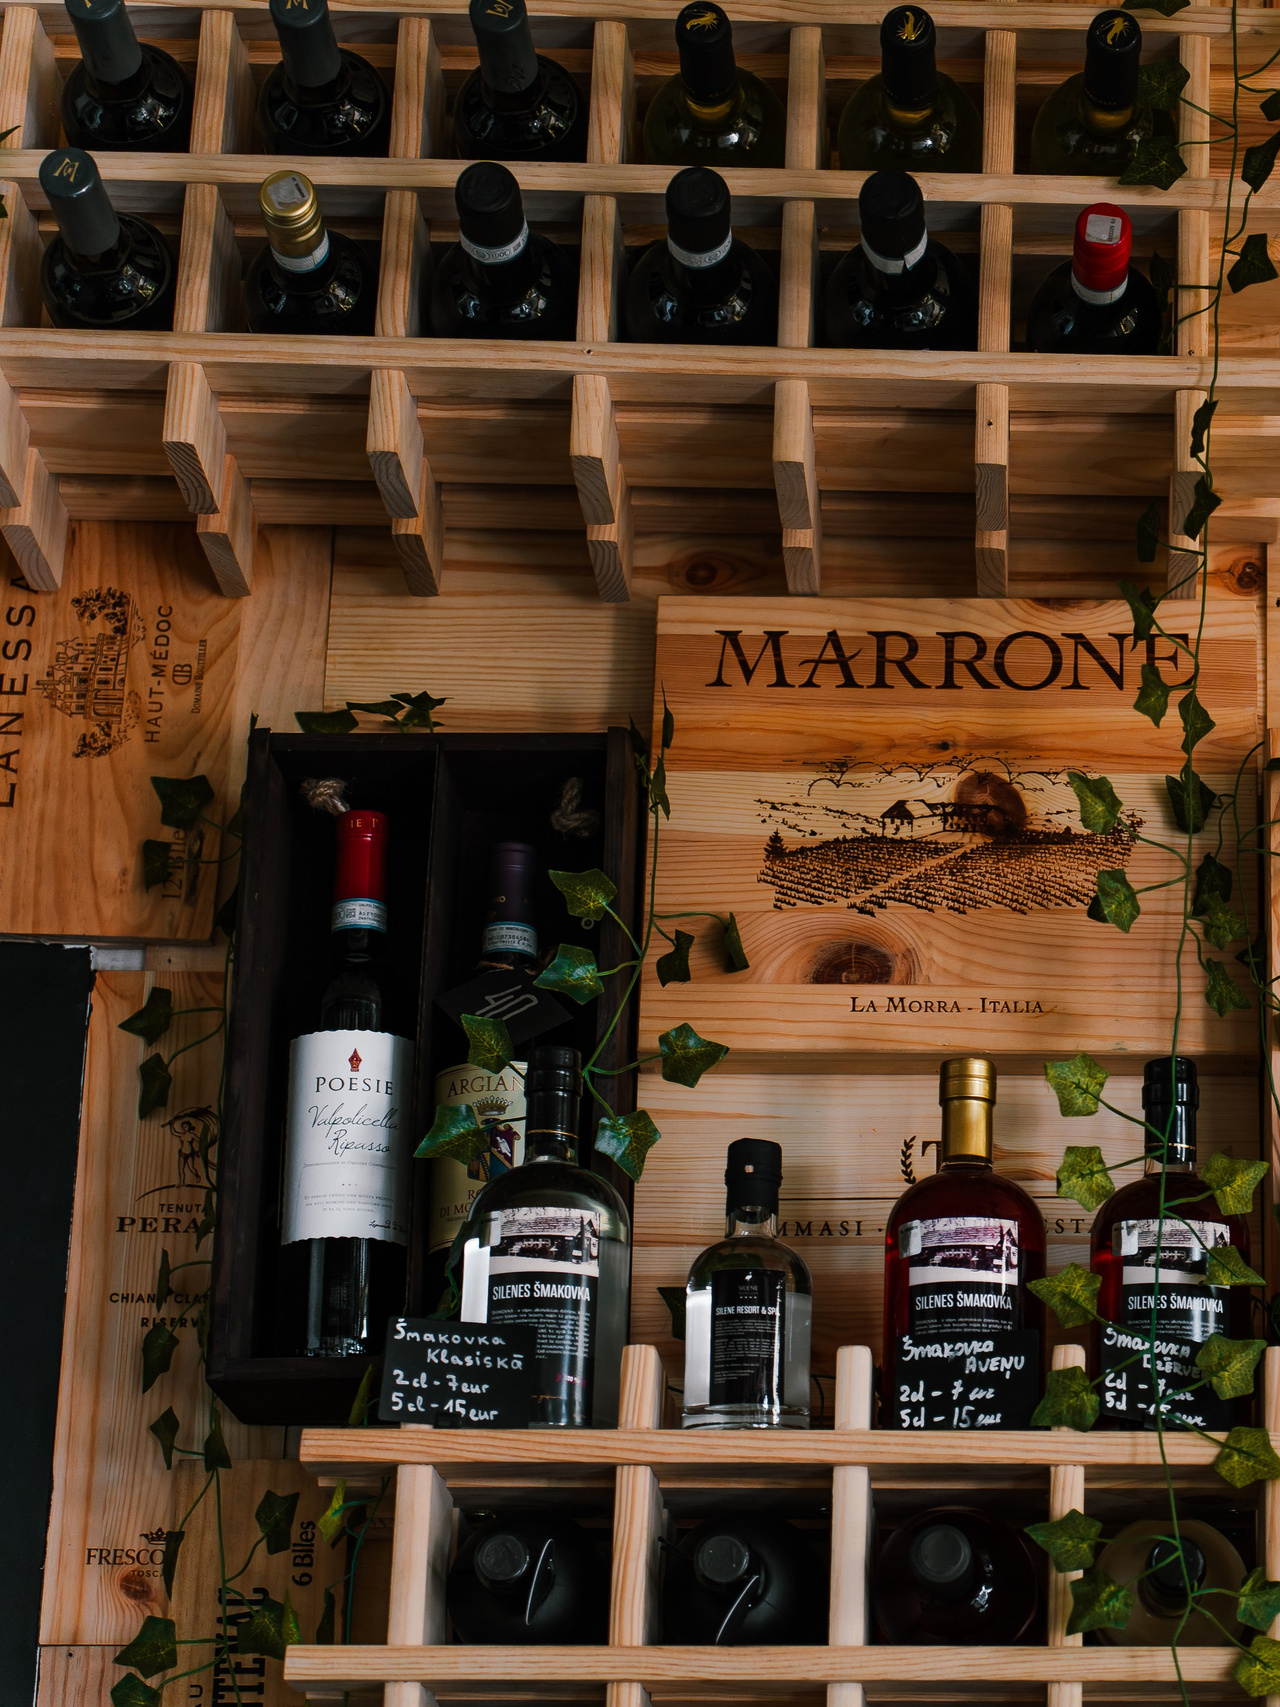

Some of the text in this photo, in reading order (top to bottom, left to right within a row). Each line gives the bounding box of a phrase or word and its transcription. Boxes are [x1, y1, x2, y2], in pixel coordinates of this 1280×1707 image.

[705, 628, 1196, 692] MARRONE
[145, 605, 173, 743] HAUT-MÉDOC
[849, 996, 1044, 1014] LA MORRA ITALIA
[315, 1076, 394, 1096] POESIE
[308, 1102, 400, 1138] Valpolicella
[328, 1128, 391, 1158] Ripasso
[775, 1220, 863, 1238] MMASI
[492, 1281, 591, 1302] SILENES ŠMAKOVKA
[915, 1291, 1012, 1311] SILENES ŠMAKOVKA
[715, 1305, 736, 1316] SILENE
[736, 1305, 760, 1315] RESORT
[761, 1306, 767, 1315] &
[1127, 1293, 1223, 1313] SILENES ŠMAKOVKA
[393, 1317, 507, 1346] Šmakovka
[292, 1573, 313, 1587] 6
